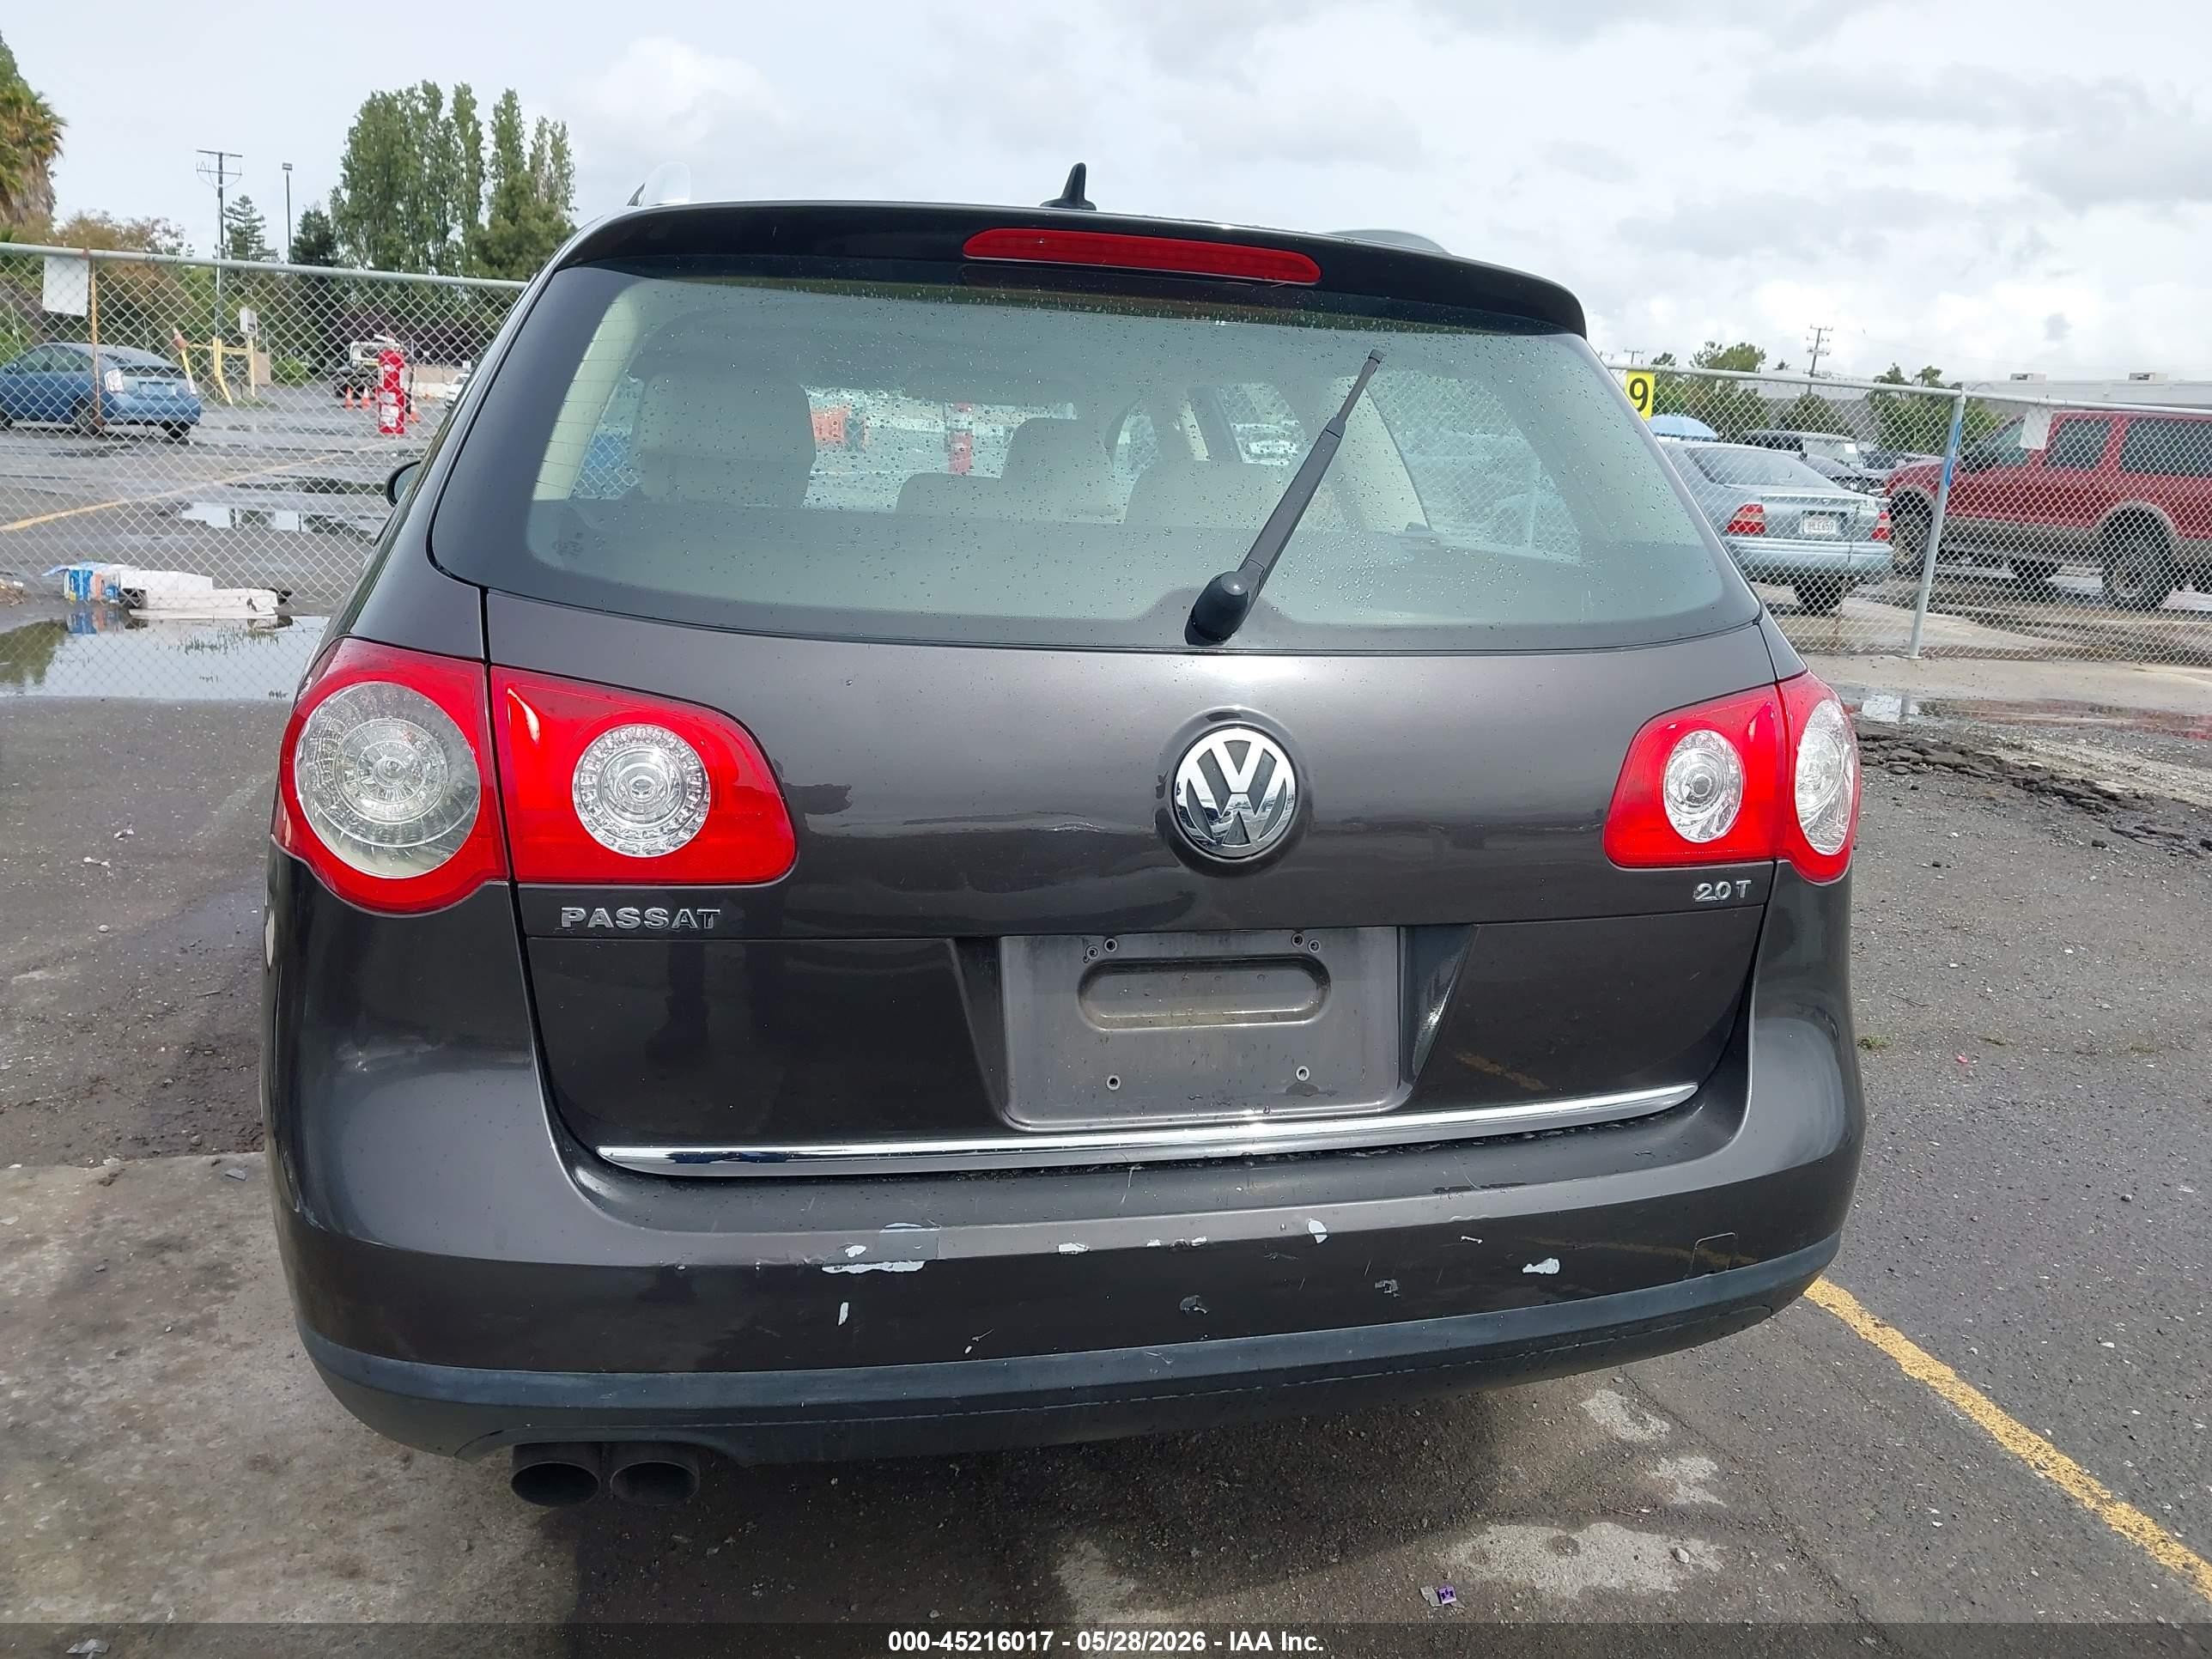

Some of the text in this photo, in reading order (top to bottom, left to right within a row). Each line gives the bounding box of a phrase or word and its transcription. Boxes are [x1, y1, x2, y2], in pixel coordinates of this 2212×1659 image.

[1629, 377, 1649, 413] 9
[1176, 727, 1296, 858] VW
[561, 907, 721, 929] PASSAT
